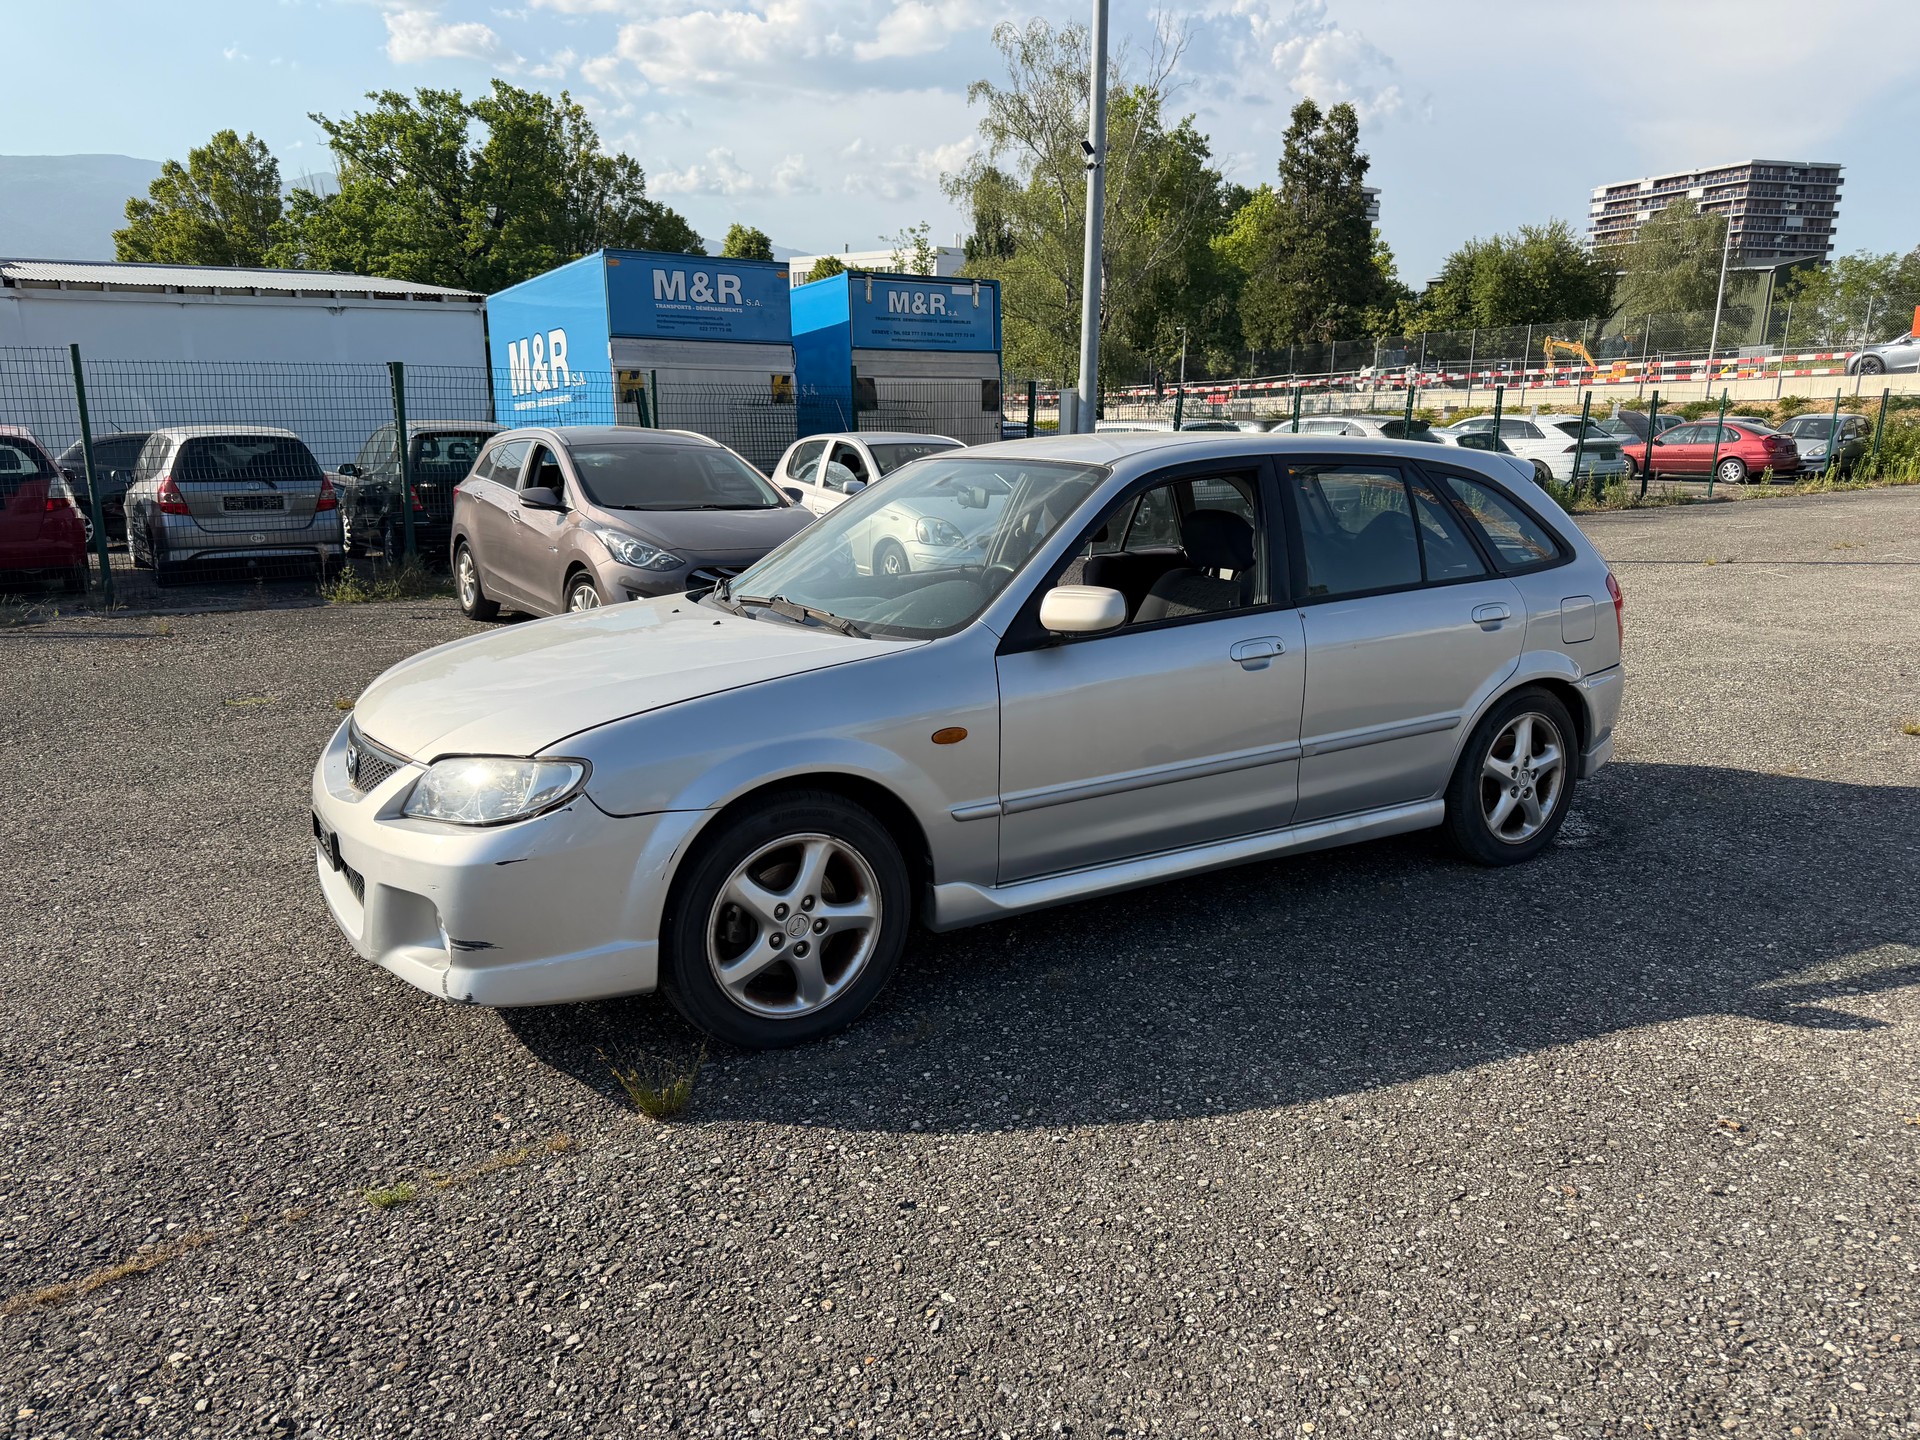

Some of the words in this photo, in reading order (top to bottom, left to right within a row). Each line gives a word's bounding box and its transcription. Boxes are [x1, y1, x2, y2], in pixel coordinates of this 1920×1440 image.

[652, 268, 744, 305] M&R
[745, 298, 763, 307] S.A.
[888, 290, 947, 316] M&R
[655, 303, 692, 311] TRANSPORTS
[508, 327, 571, 397] M&R
